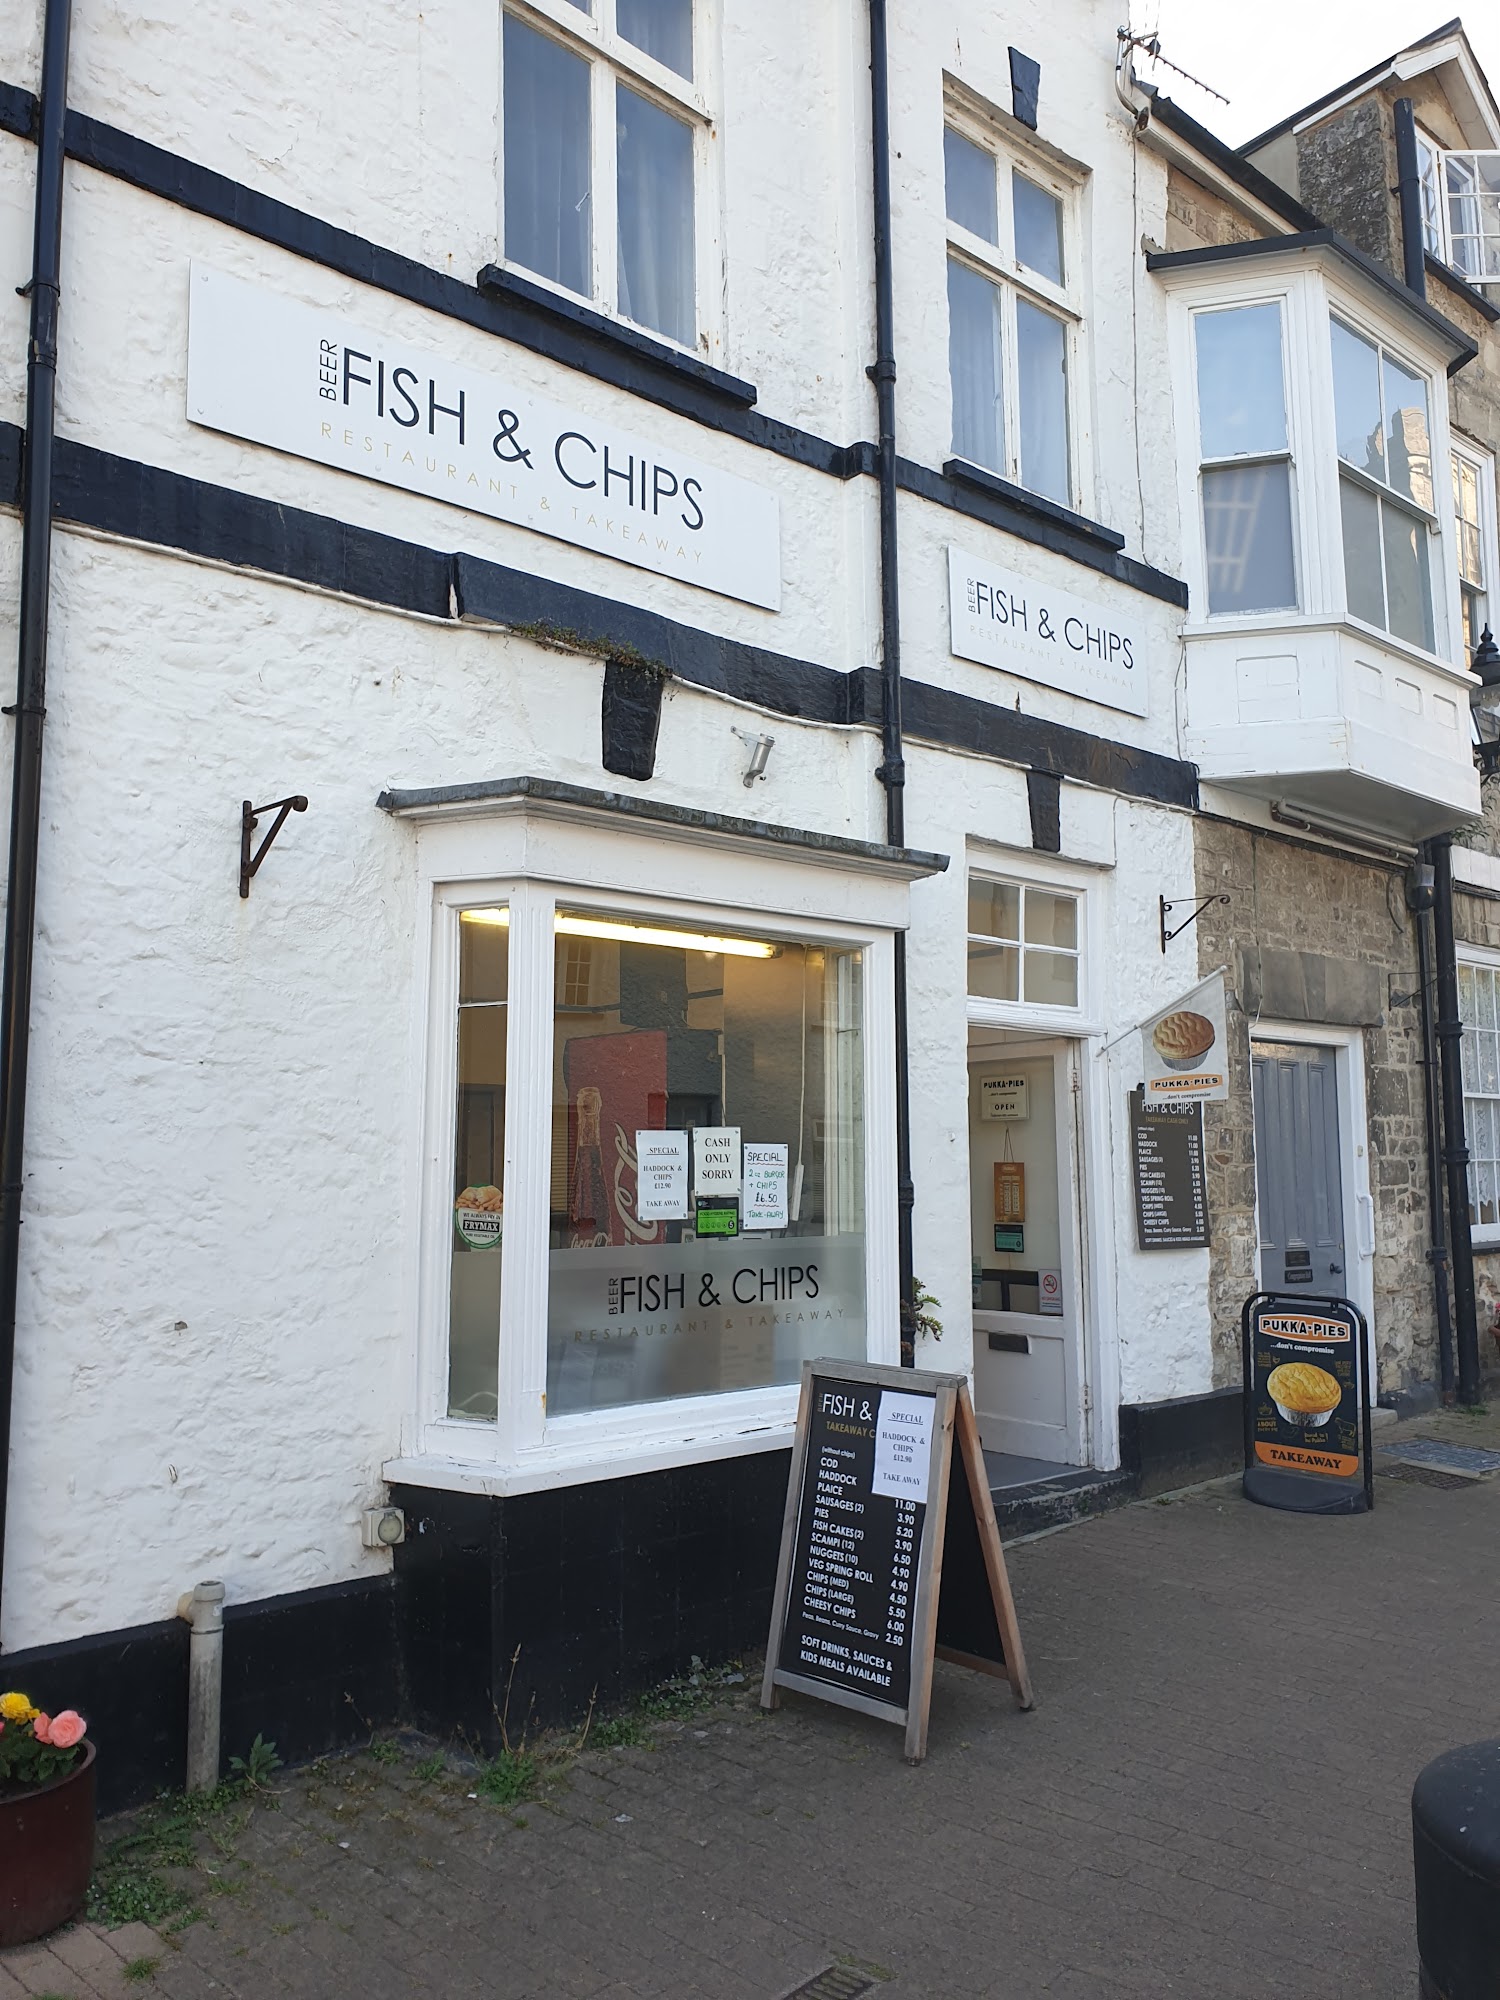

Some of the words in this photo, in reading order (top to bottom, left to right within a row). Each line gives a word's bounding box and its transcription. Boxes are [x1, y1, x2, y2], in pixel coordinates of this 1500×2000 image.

[319, 338, 338, 401] BEER
[343, 347, 466, 446] FISH
[492, 409, 535, 470] &
[554, 432, 704, 531] CHIPS
[321, 421, 518, 500] RESTAURANT
[540, 496, 551, 512] &
[572, 506, 703, 564] TAKEAWAY
[967, 578, 976, 613] BEER
[976, 581, 1028, 632] FISH
[1038, 608, 1056, 642] &
[1064, 617, 1134, 670] CHIPS
[970, 625, 1050, 660] RESTAURANT
[1073, 661, 1134, 690] TAKEAWAY
[1170, 1102, 1194, 1115] CHIPS
[705, 1138, 731, 1147] CASH
[705, 1154, 731, 1164] ONLY
[747, 1152, 783, 1162] SPECIAL
[702, 1169, 734, 1179] SORRY
[763, 1171, 785, 1179] BURGER
[756, 1181, 778, 1190] CHIPS
[646, 1200, 663, 1208] TAKE
[756, 1193, 778, 1203] £6.50
[464, 1221, 498, 1231] FRYMAX
[729, 1221, 734, 1229] 5
[608, 1277, 619, 1315] BEER
[620, 1273, 685, 1314] FISH
[698, 1272, 722, 1307] &
[733, 1265, 819, 1304] CHIPS
[575, 1321, 709, 1342] RESTAURANT
[725, 1319, 734, 1329] &
[748, 1308, 845, 1326] TAKEAWAY
[1294, 1345, 1334, 1354] compromise
[823, 1393, 855, 1417] FISH
[860, 1401, 872, 1421] &
[891, 1412, 923, 1423] SPECIAL
[826, 1421, 867, 1436] TAKEAWAY
[882, 1432, 917, 1444] HADDOCK
[841, 1450, 855, 1459] chips)
[892, 1443, 914, 1454] CHIPS
[893, 1454, 912, 1463] £12.90
[820, 1457, 838, 1468] COD
[1270, 1449, 1342, 1469] TAKEAWAY
[819, 1469, 858, 1485] HADDOCK
[883, 1472, 901, 1483] TAKE
[902, 1475, 921, 1486] AWAY
[817, 1482, 843, 1495] PLAICE
[895, 1499, 916, 1512] 11.00
[816, 1494, 854, 1511] SAUSAGES
[855, 1503, 864, 1514] (2)
[897, 1513, 915, 1525] 3.90
[814, 1507, 829, 1518] PIES
[896, 1527, 914, 1539] 5.20
[813, 1520, 828, 1532] FISH
[829, 1523, 854, 1538] CAKES
[855, 1529, 864, 1540] (2)
[894, 1539, 912, 1552] 3.90
[811, 1532, 840, 1547] SCAMPI
[842, 1539, 855, 1551] (12)
[893, 1553, 911, 1566] 6.50
[810, 1545, 844, 1562] NUGGETS
[845, 1552, 858, 1565] (10)
[892, 1566, 909, 1579] 4.90
[808, 1558, 824, 1570] VEG
[825, 1561, 853, 1577] SPRING
[854, 1570, 873, 1583] ROLL
[890, 1579, 908, 1592] 4.90
[806, 1571, 828, 1585] CHIPS
[829, 1577, 849, 1590] (MED)
[889, 1592, 907, 1605] 4.50
[805, 1584, 827, 1597] CHIPS
[828, 1589, 854, 1605] (LARGE)
[888, 1606, 906, 1619] 5.50
[804, 1596, 832, 1612] CHEESY
[833, 1604, 856, 1619] CHIPS
[887, 1620, 905, 1632] 6.00
[863, 1629, 879, 1640] Gravy
[885, 1633, 903, 1646] 2.50
[801, 1635, 820, 1648] SOFT
[821, 1641, 851, 1659] DRINKS,
[853, 1650, 885, 1668] SAUCES
[886, 1661, 893, 1671] &
[800, 1650, 818, 1663] KIDS
[819, 1656, 845, 1672] MEALS
[846, 1665, 891, 1686] AVAILABLE
